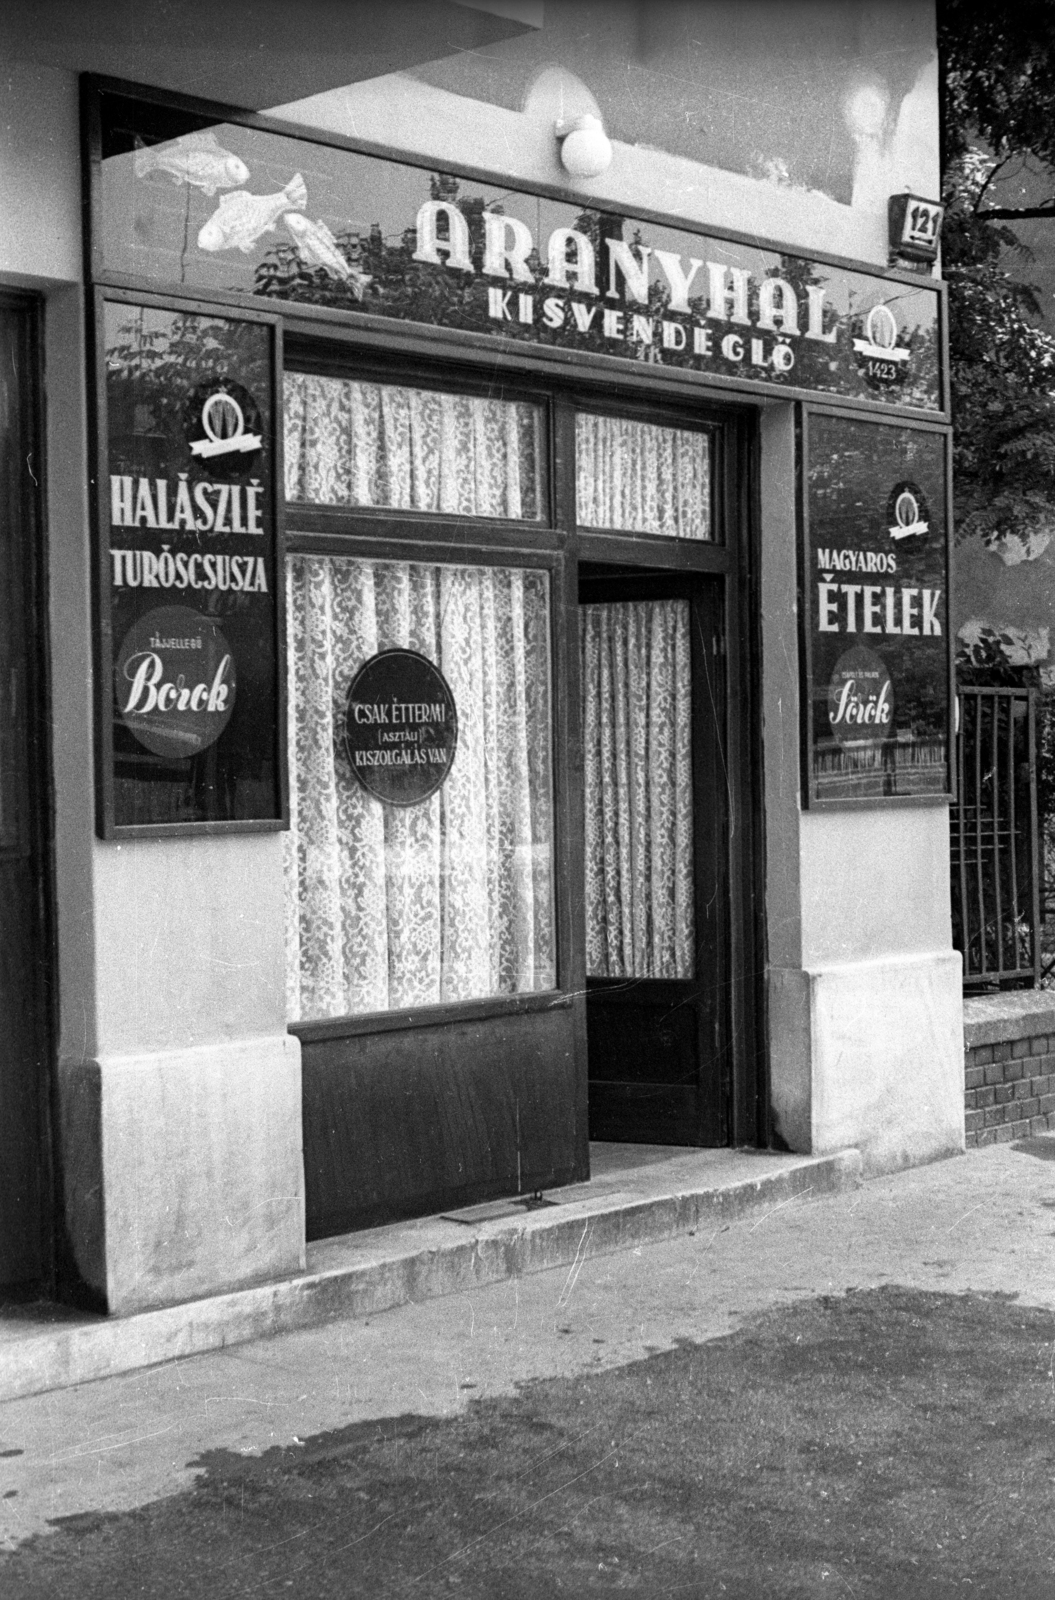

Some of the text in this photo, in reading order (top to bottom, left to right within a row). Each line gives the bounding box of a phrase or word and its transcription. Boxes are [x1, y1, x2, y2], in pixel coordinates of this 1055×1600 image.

[911, 206, 939, 236] 121
[412, 200, 837, 343] ARANYHAL
[868, 361, 897, 379] 1423
[110, 472, 264, 535] HALÁSZLÉ
[109, 544, 268, 592] TURÓSCSUSZA
[817, 548, 897, 573] MAGYAROS
[817, 573, 942, 636] ÉTELEK
[123, 651, 230, 714] Borok
[829, 679, 891, 724] Sörök
[354, 697, 446, 724] CSAK ÉTTERMI
[355, 743, 447, 766] KISZOLGÁLÁS VAN
